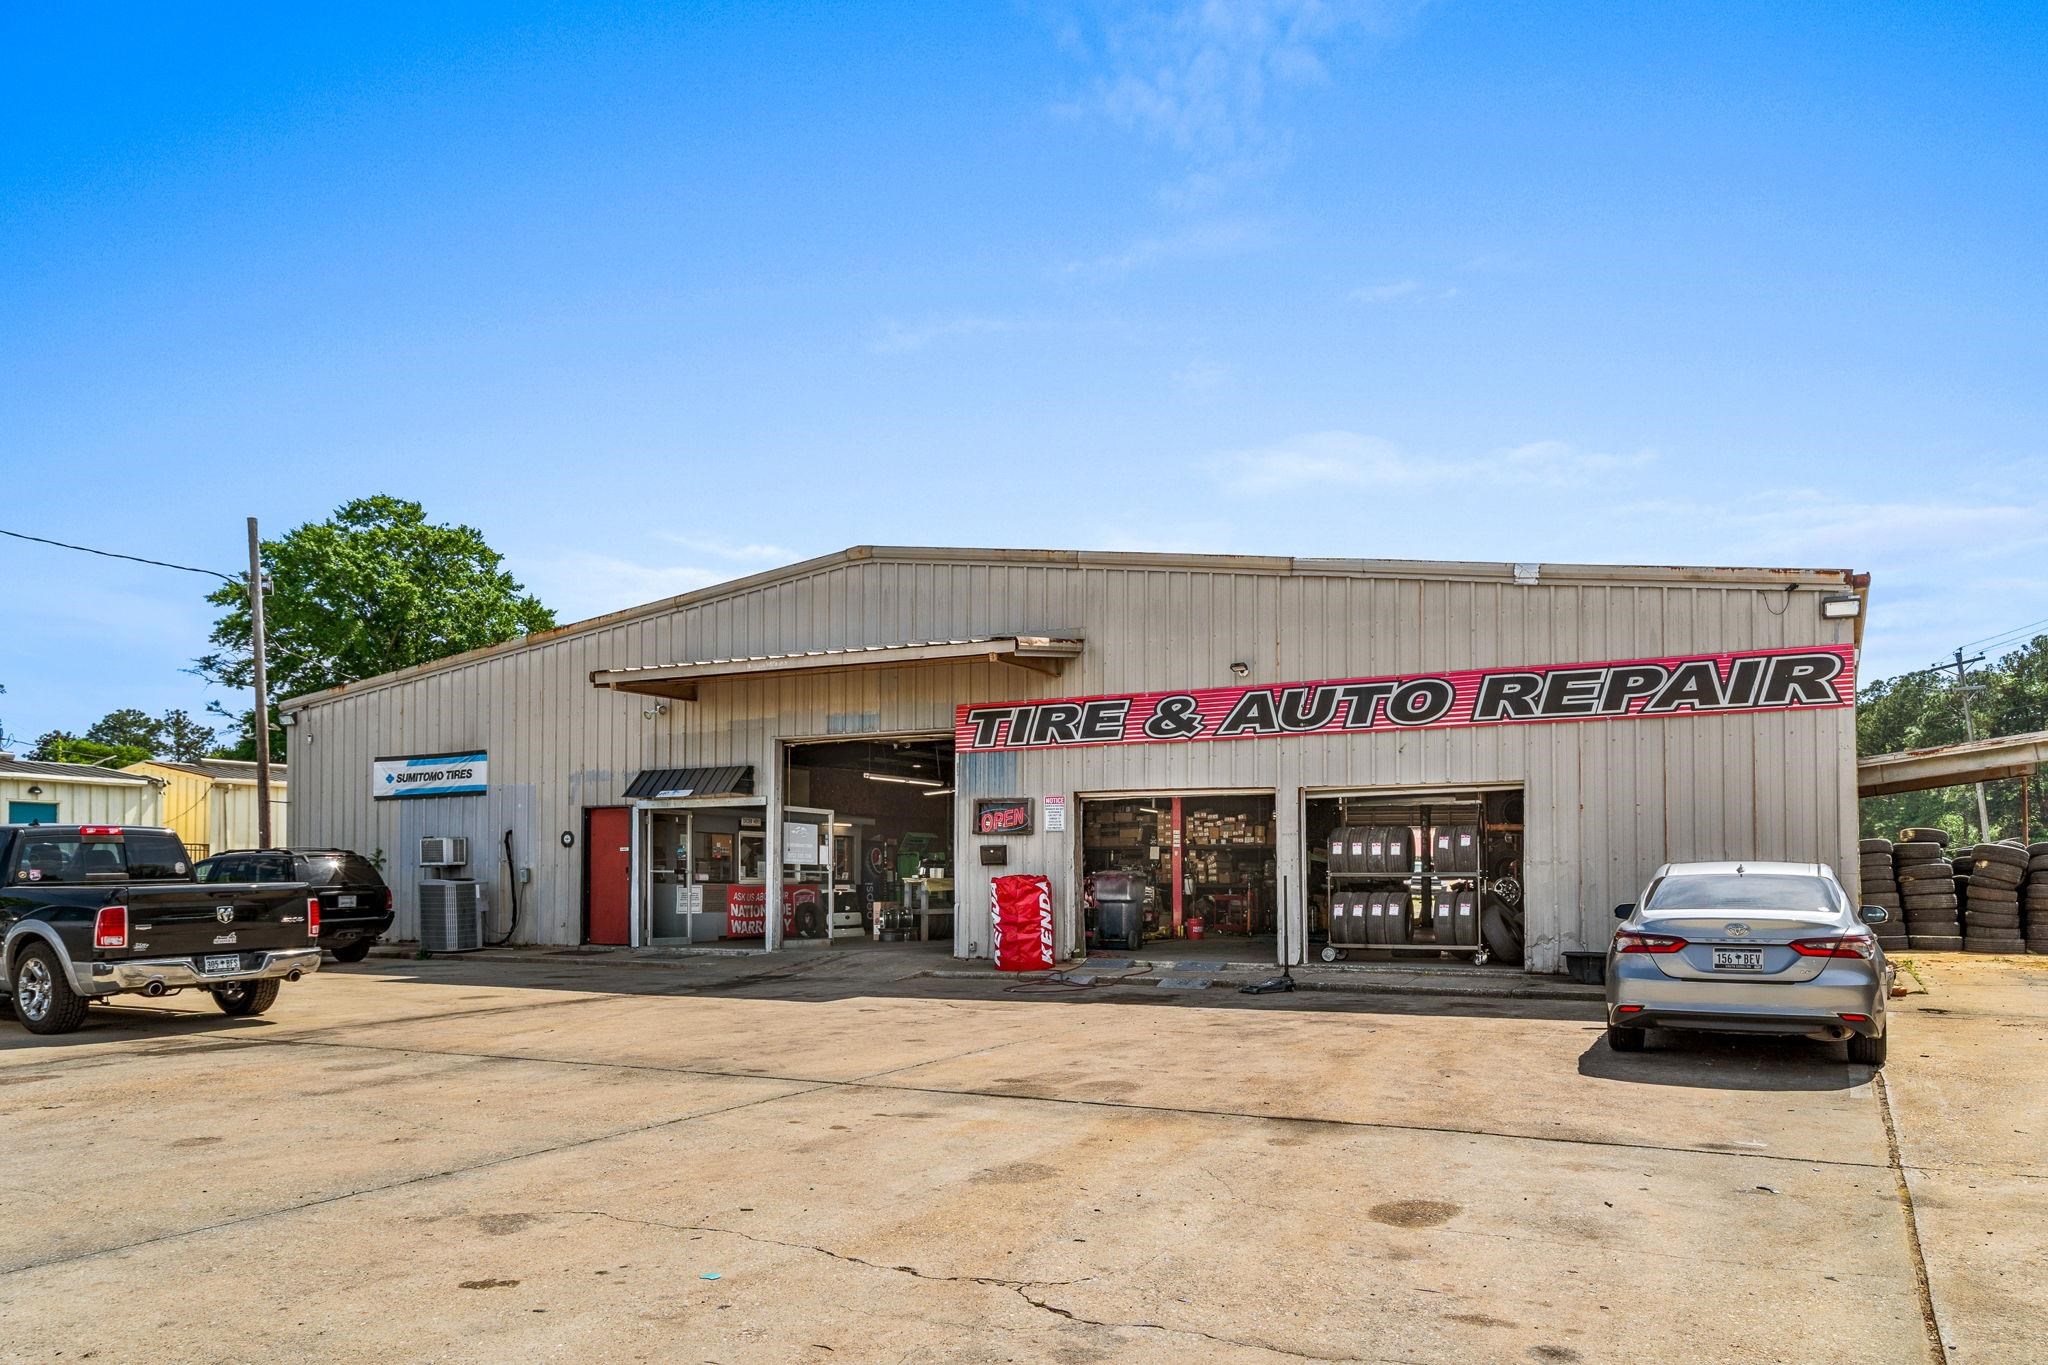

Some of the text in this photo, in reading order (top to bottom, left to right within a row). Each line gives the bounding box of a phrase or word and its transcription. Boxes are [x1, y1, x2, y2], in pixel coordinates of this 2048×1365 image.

[967, 652, 1848, 749] TIRE & AUTO REPAIR
[396, 768, 473, 783] SUMITOMO TIRES
[981, 807, 1025, 832] OPEN
[733, 892, 745, 901] ASK
[747, 893, 755, 901] US
[730, 903, 792, 918] NATIONE
[730, 918, 792, 934] WARRY
[1034, 881, 1054, 965] KENDA
[206, 960, 219, 969] 305
[1716, 953, 1761, 964] 156 BEV
